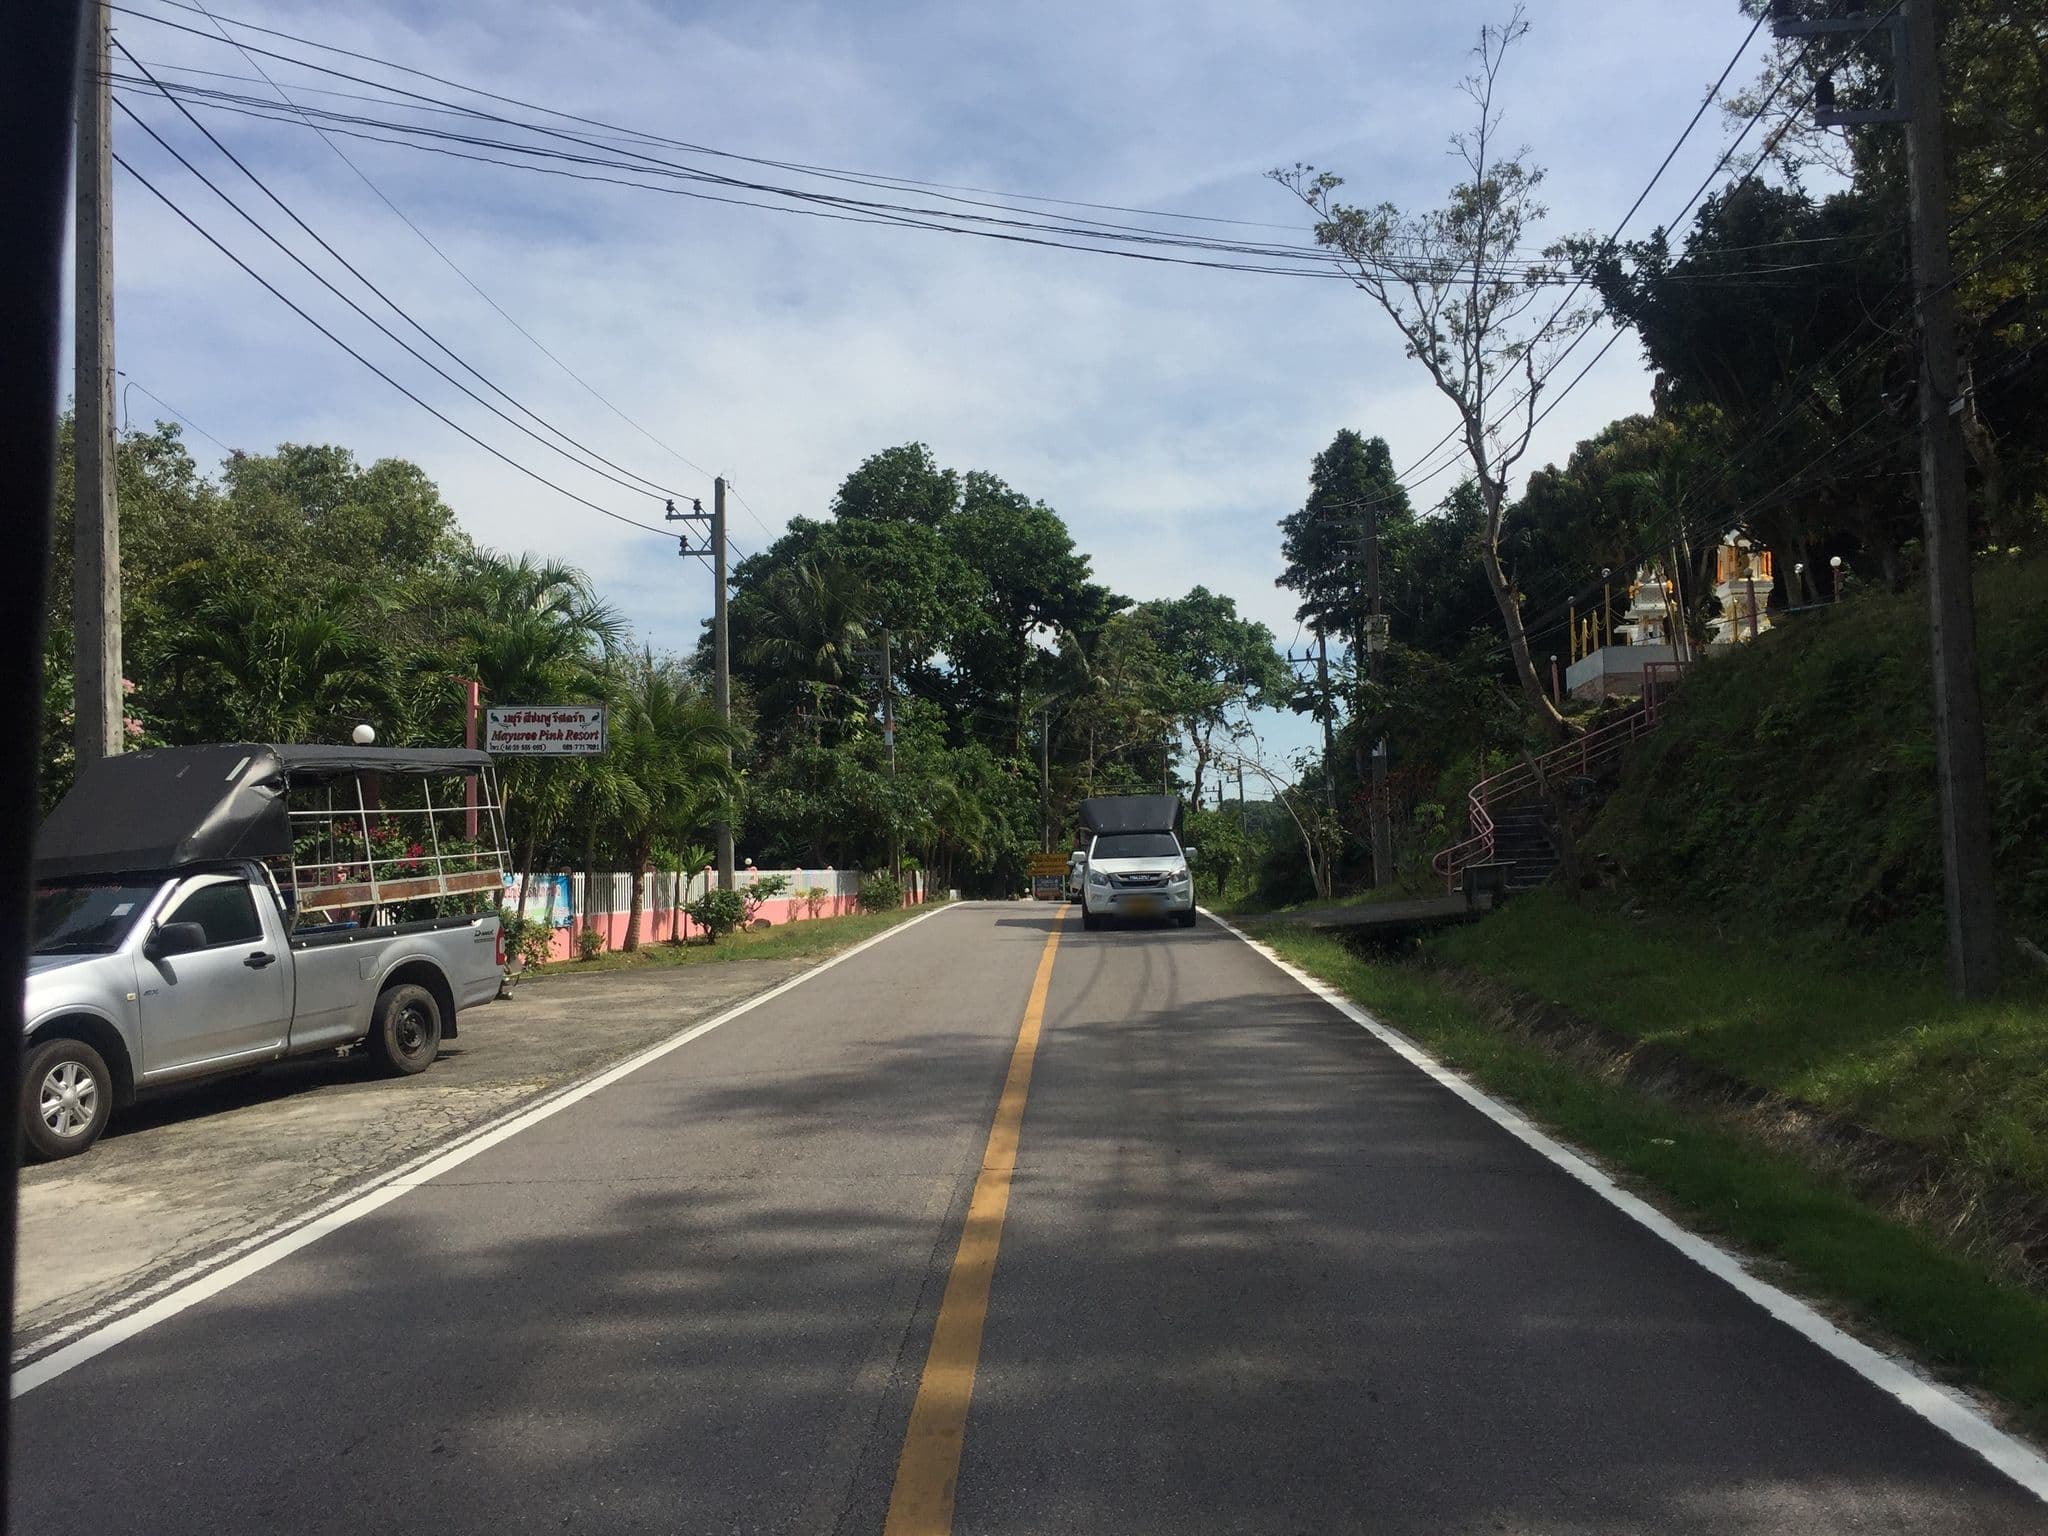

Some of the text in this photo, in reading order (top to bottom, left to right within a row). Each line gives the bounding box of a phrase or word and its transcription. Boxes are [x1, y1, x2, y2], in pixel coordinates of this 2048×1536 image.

[492, 729, 599, 743] Mayuree Pink Resort
